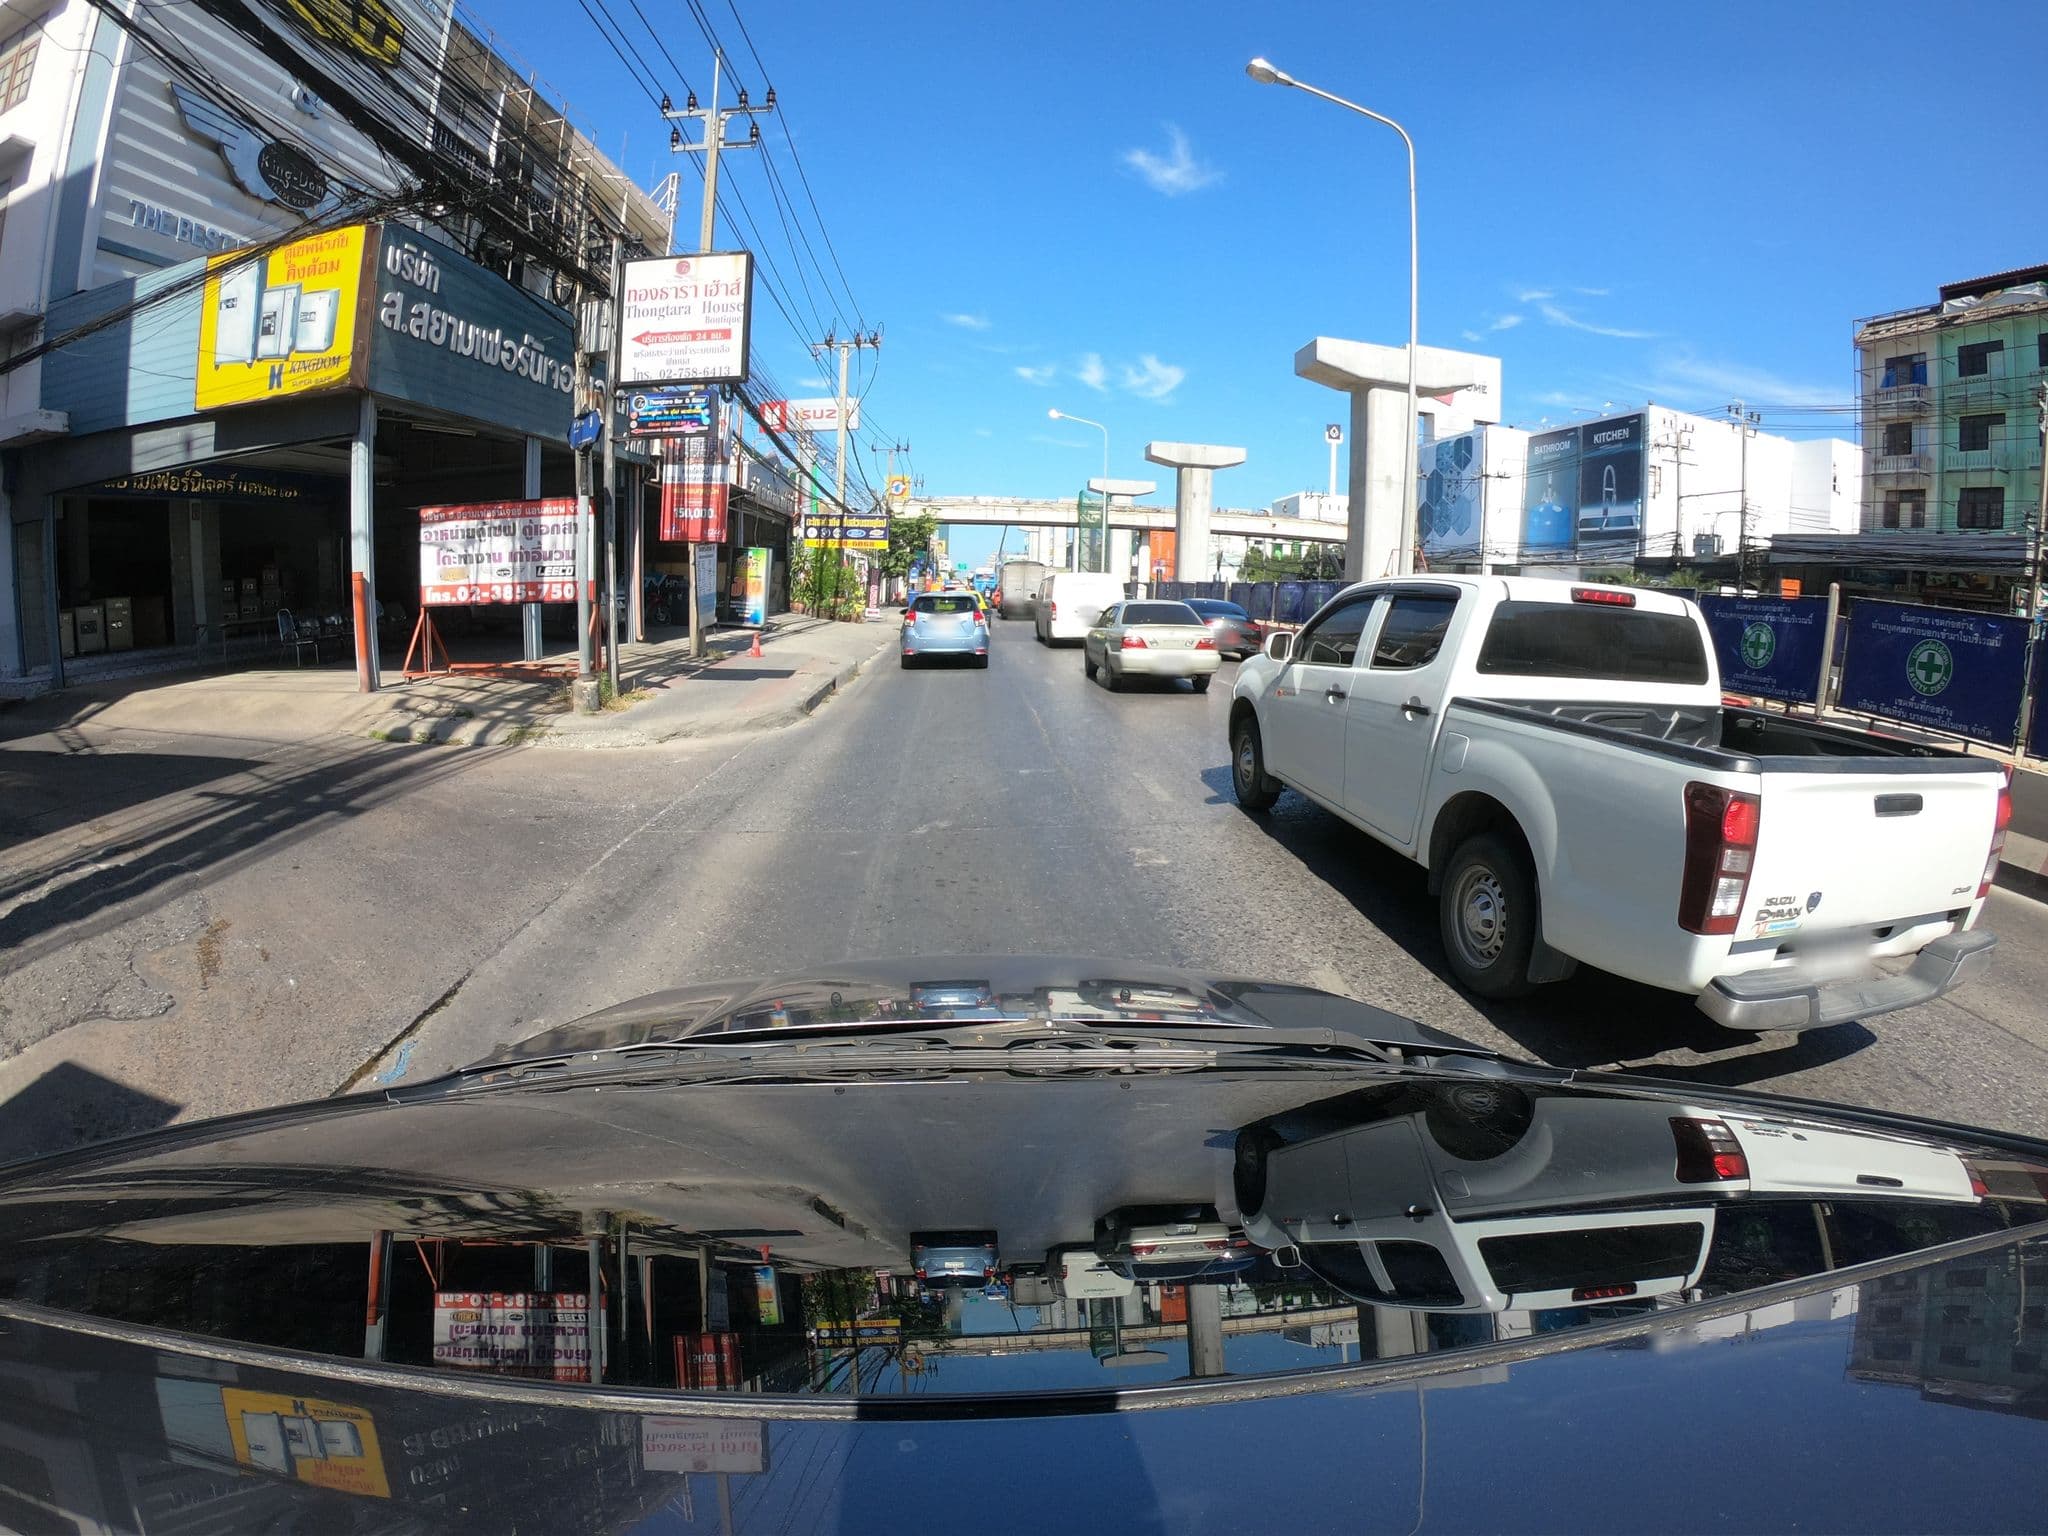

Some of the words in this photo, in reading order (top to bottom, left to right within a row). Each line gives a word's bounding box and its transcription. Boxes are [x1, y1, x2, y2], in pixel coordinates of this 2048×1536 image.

[129, 199, 177, 237] THE
[175, 216, 229, 250] BEST
[386, 243, 441, 295] บริษัท
[626, 283, 698, 304] ทองธารา
[625, 304, 691, 321] Thongtara
[702, 300, 744, 315] House
[705, 315, 742, 326] Boutique
[380, 290, 577, 395] ส.สยามเฟอร์นิเจอ
[659, 366, 731, 379] 02-758-6413
[1593, 428, 1630, 444] KITCHEN
[1534, 441, 1571, 455] BATHROOM
[522, 519, 580, 540] ตู้เอกสา
[538, 567, 574, 577] LEECO
[1764, 896, 1796, 907] ISUZU
